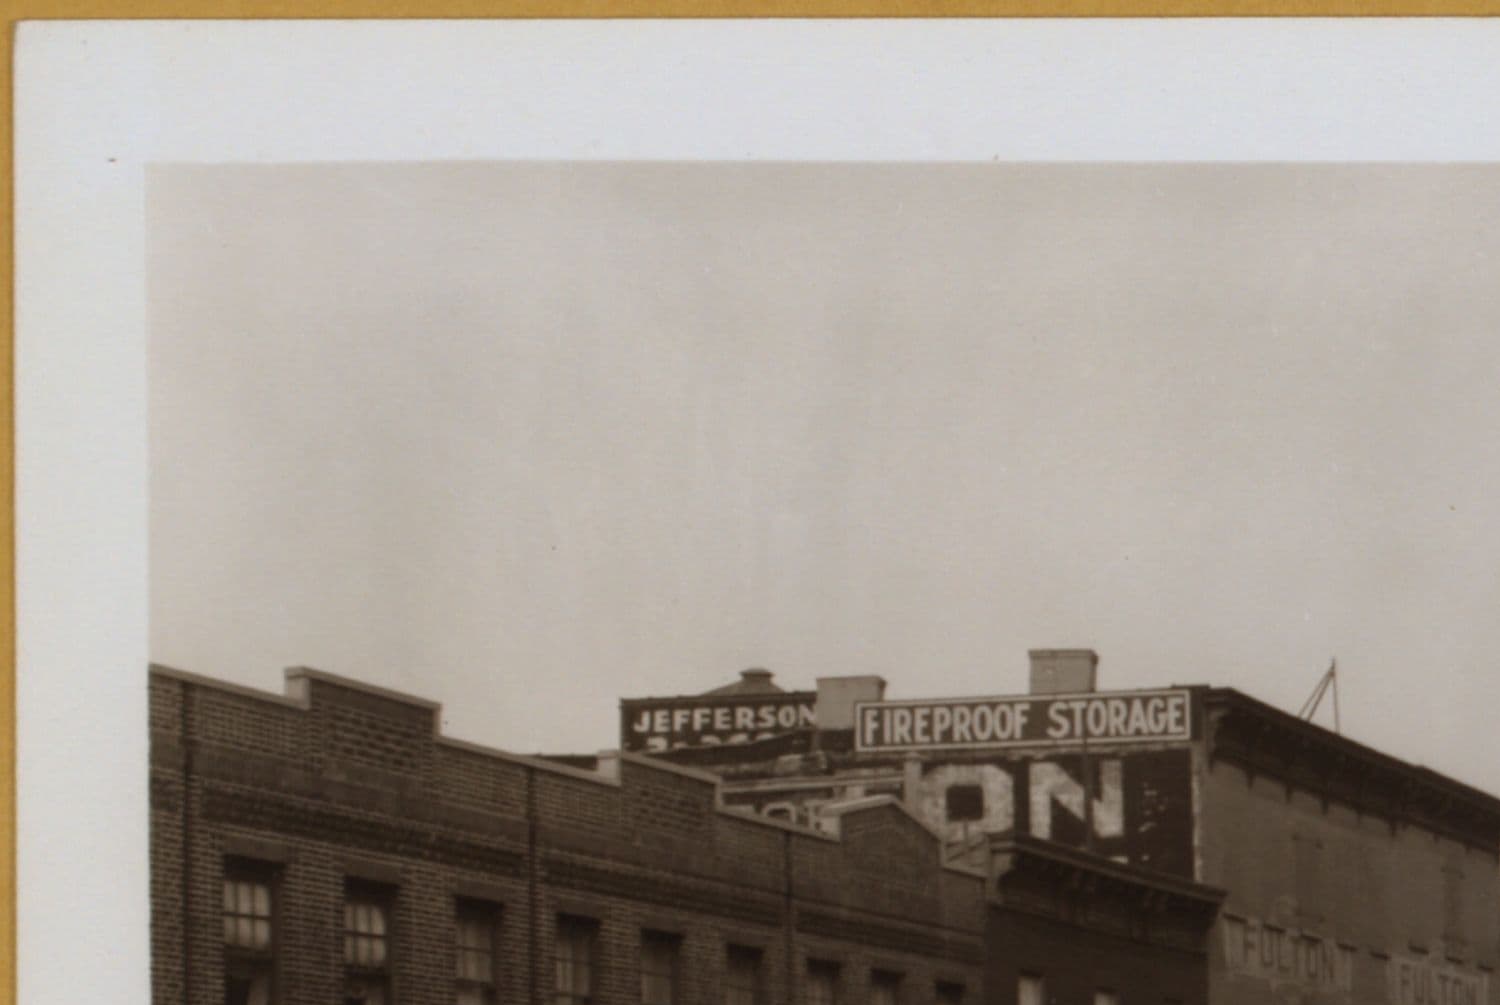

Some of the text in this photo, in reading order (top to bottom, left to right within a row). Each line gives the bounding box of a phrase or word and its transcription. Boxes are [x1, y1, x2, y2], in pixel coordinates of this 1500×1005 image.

[633, 704, 816, 733] JEFFERSON
[863, 697, 1185, 745] FIREPROOF STORAGE
[1242, 925, 1337, 984] FULTON
